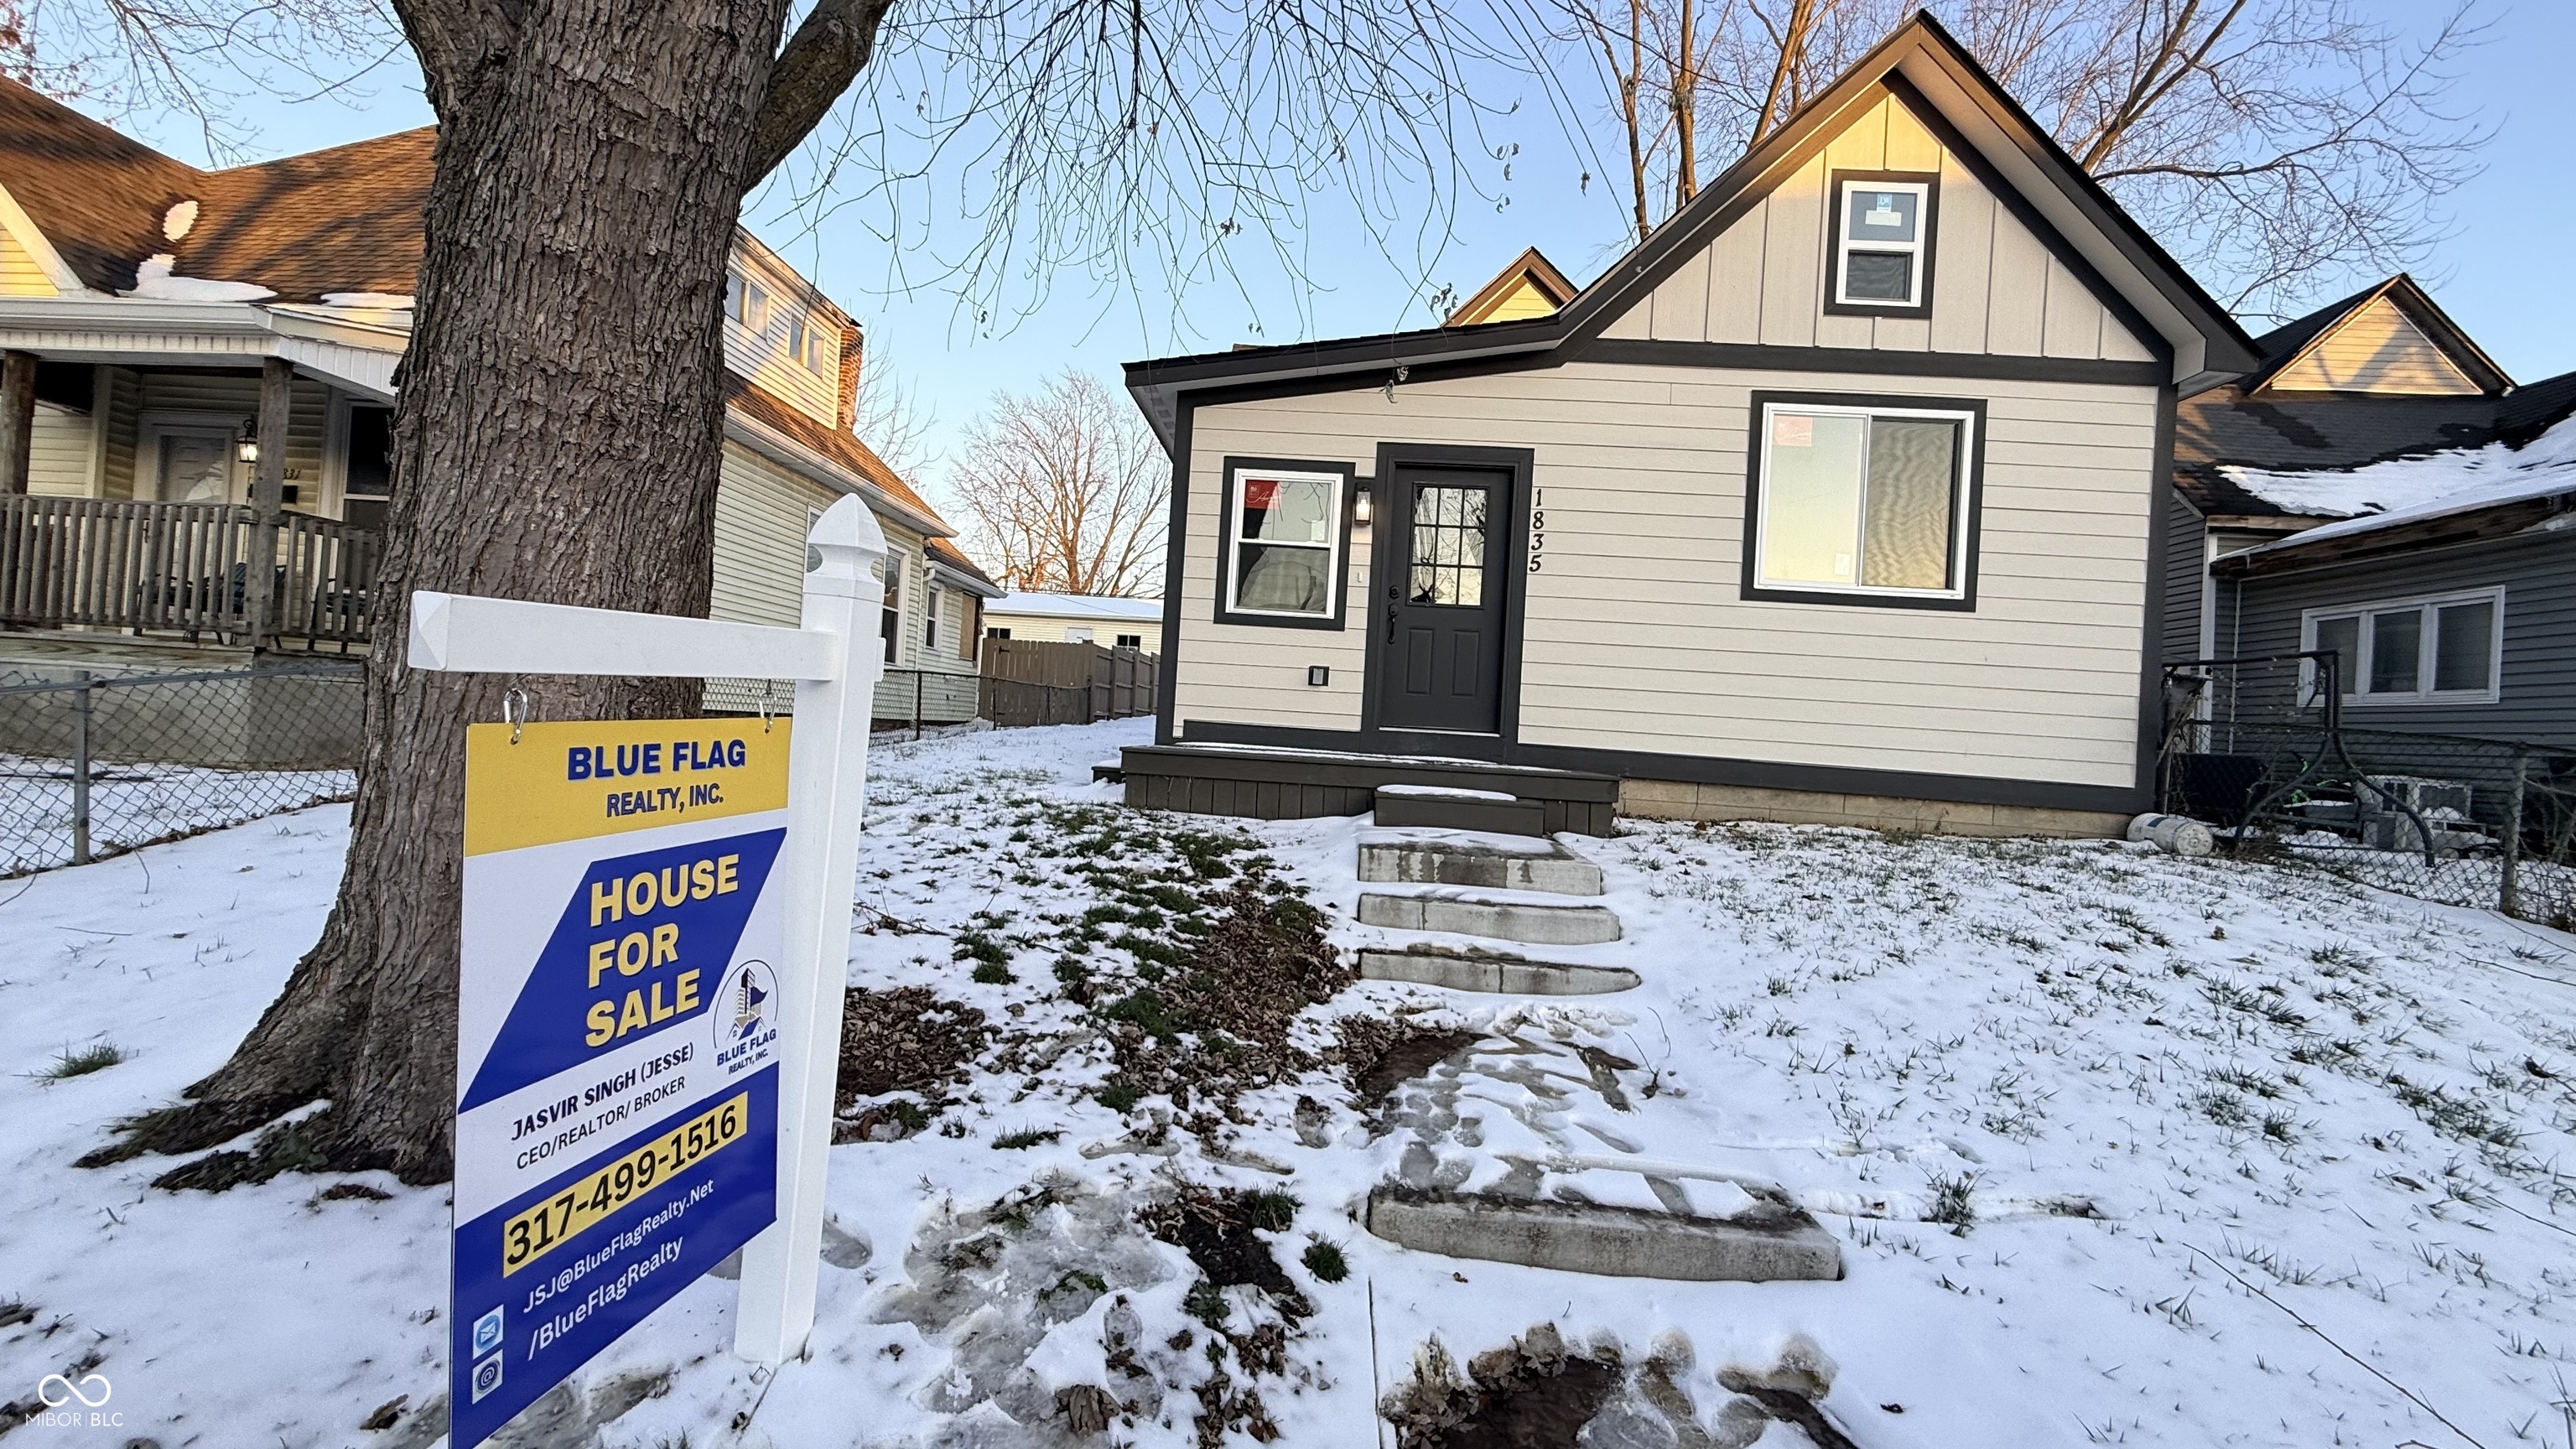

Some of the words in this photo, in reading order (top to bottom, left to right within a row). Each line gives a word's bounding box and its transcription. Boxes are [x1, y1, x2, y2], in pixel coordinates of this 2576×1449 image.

[1529, 488, 1545, 572] 1835
[568, 744, 662, 781] BLUE
[673, 739, 746, 771] FLAG
[606, 788, 685, 818] REALTY,
[689, 783, 724, 806] INC.
[590, 854, 740, 928] HOUSE
[589, 923, 679, 989] FOR
[585, 969, 700, 1048] SALE
[717, 1041, 746, 1067] BLUE
[750, 1028, 776, 1051] FLAG
[729, 1055, 755, 1075] REALTY,
[756, 1048, 768, 1062] INC.
[511, 1095, 579, 1141] JASVIR
[584, 1068, 636, 1107] SINGH
[641, 1041, 694, 1083] (JESSE)
[635, 1076, 686, 1113] BROKER
[506, 1104, 736, 1265] 317-499-1516
[523, 1179, 714, 1313] JSJ@BlueFlagRealty.Net
[527, 1236, 683, 1362] /BlueFlagRealty
